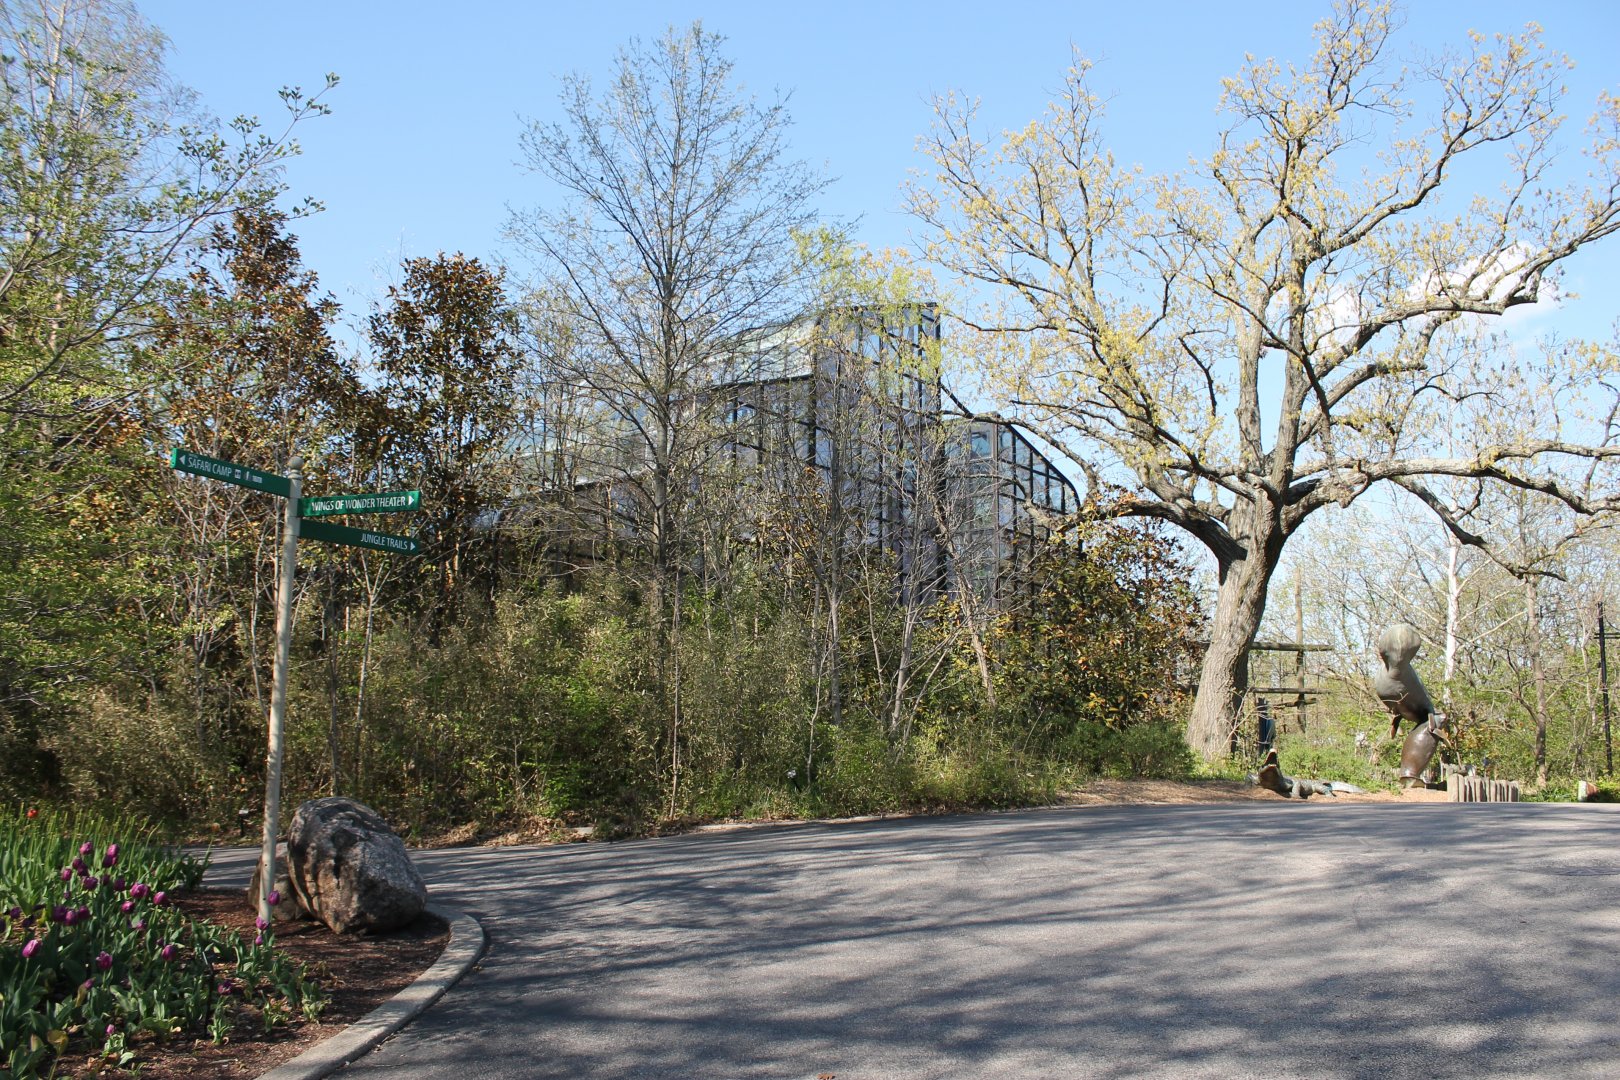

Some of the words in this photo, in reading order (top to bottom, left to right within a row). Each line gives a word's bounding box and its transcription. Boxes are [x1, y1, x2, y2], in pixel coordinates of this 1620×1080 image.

[188, 457, 211, 472] SAFARI
[212, 463, 232, 477] CAMP
[311, 500, 334, 511] WINGS
[335, 499, 344, 510] OF
[345, 498, 376, 510] WONDER
[376, 496, 406, 508] THEATER
[360, 533, 386, 546] JUNGLE
[386, 537, 408, 550] TRAILS
